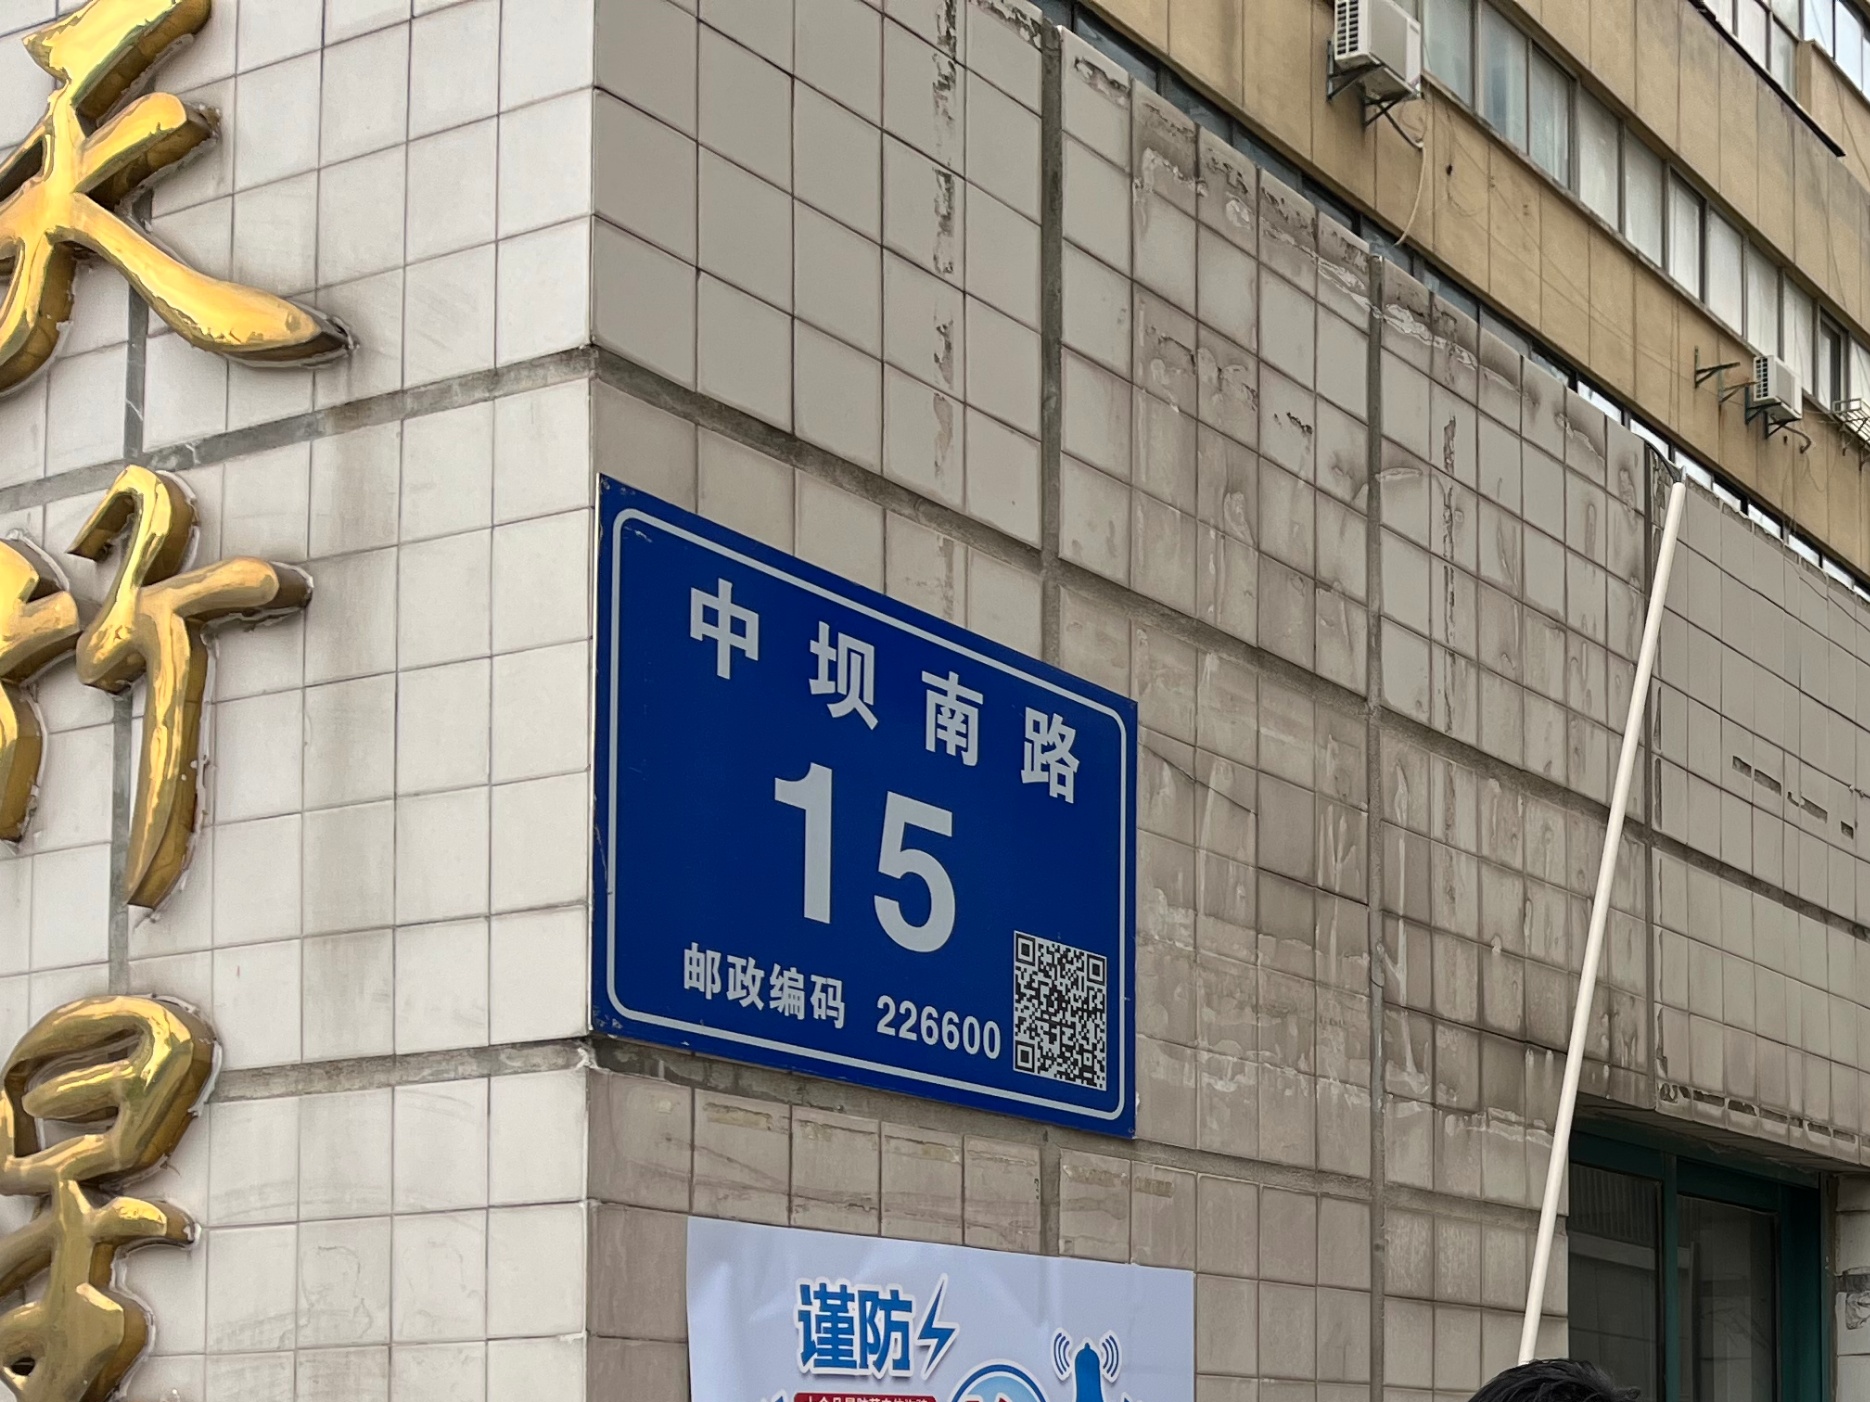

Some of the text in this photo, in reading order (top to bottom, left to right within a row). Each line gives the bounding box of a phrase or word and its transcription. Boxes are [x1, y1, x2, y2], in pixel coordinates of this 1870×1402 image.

[690, 578, 1079, 804] 中坝南路
[774, 762, 956, 953] 15
[683, 941, 1001, 1060] 邮政编码 226600
[796, 1280, 914, 1374] 谨防
